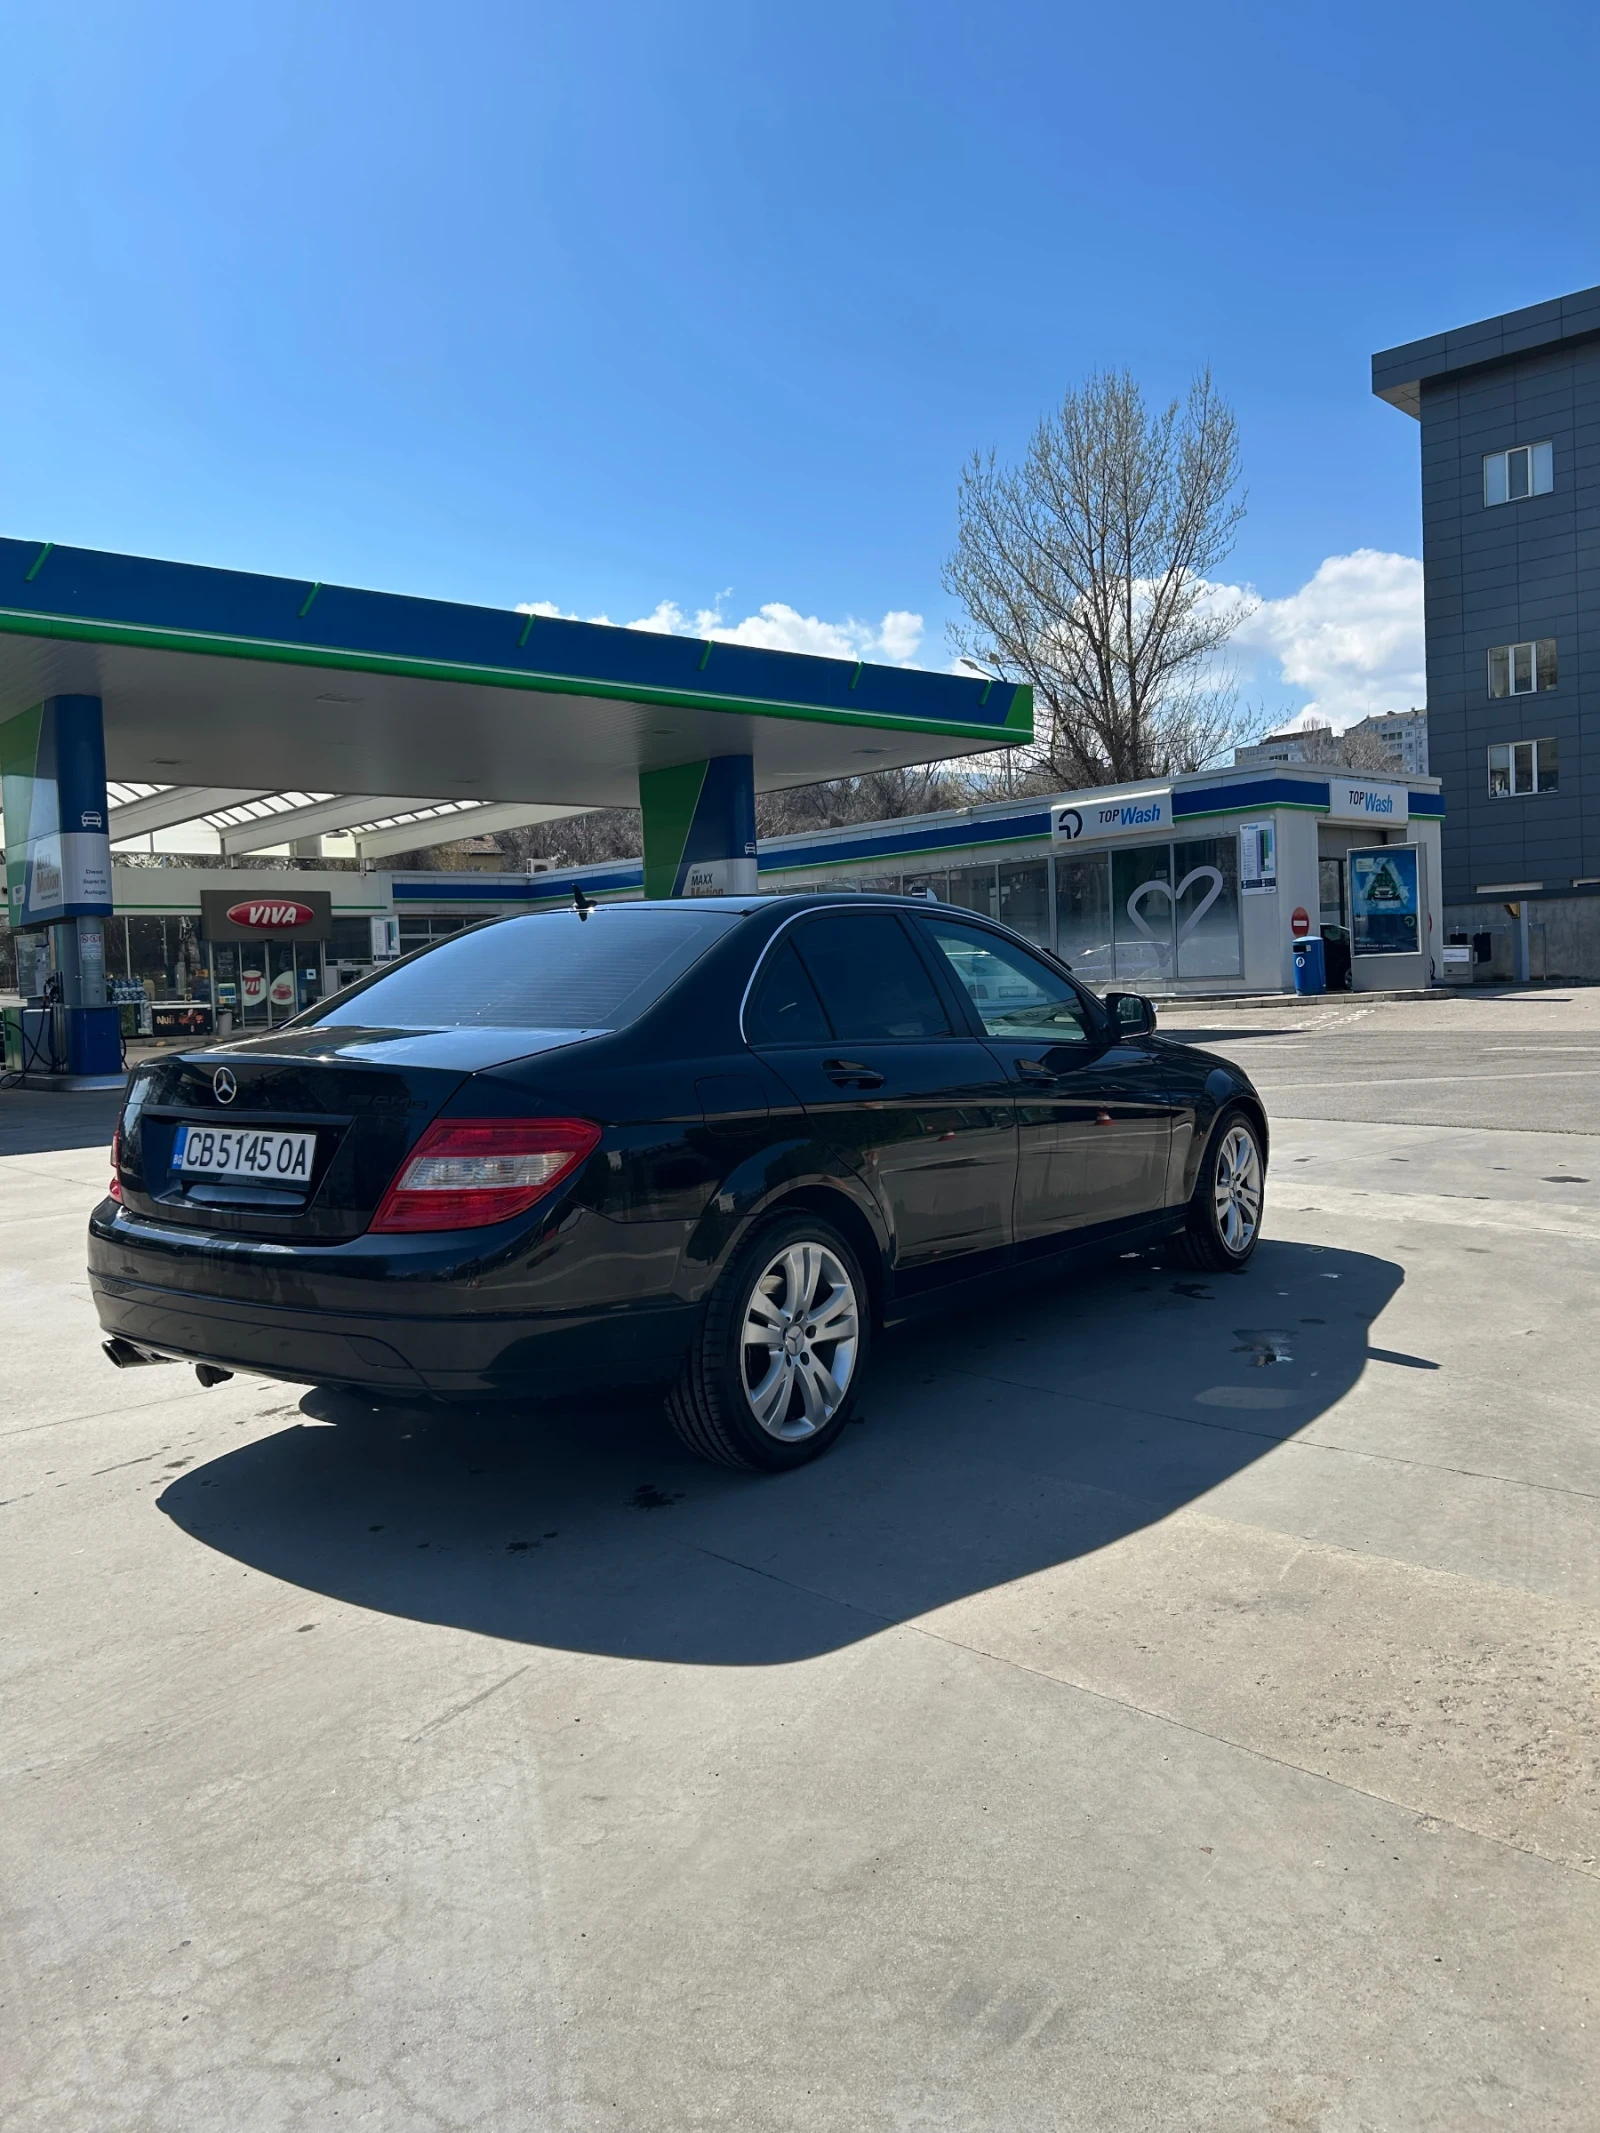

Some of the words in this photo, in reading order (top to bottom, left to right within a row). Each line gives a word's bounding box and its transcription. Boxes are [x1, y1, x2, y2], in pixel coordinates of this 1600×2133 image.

[691, 873, 713, 885] MAXX
[249, 906, 297, 924] VIVA
[173, 1154, 183, 1165] BG
